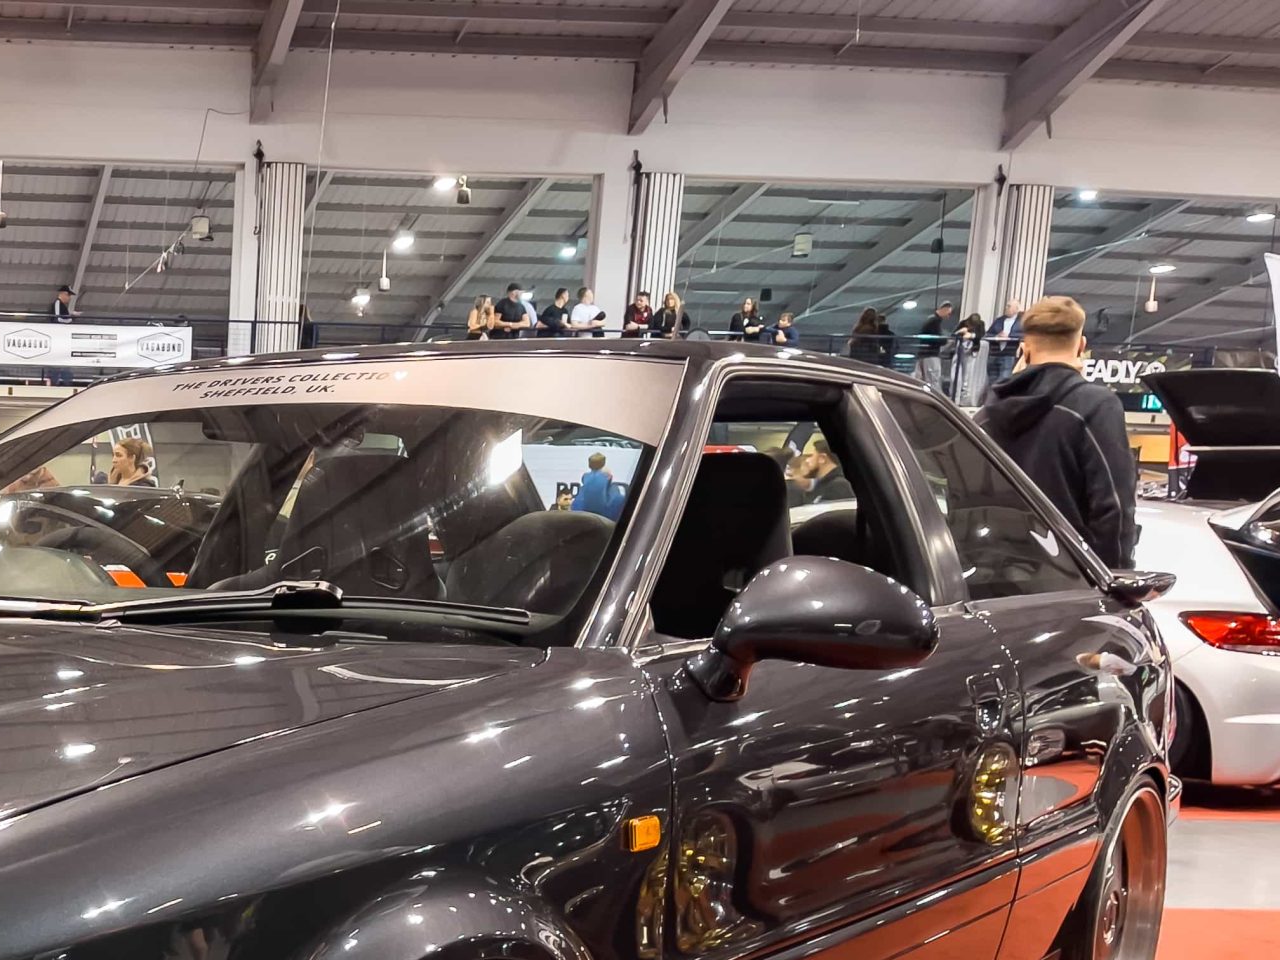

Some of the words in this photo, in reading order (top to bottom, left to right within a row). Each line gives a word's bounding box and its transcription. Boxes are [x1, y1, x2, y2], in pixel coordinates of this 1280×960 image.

[6, 338, 48, 348] VAGABOND
[140, 342, 181, 352] VAGABOND
[172, 381, 206, 391] THE
[207, 375, 285, 389] DRIVERS
[289, 372, 404, 383] COLLECTIO
[199, 385, 297, 399] SHEFFIELD,
